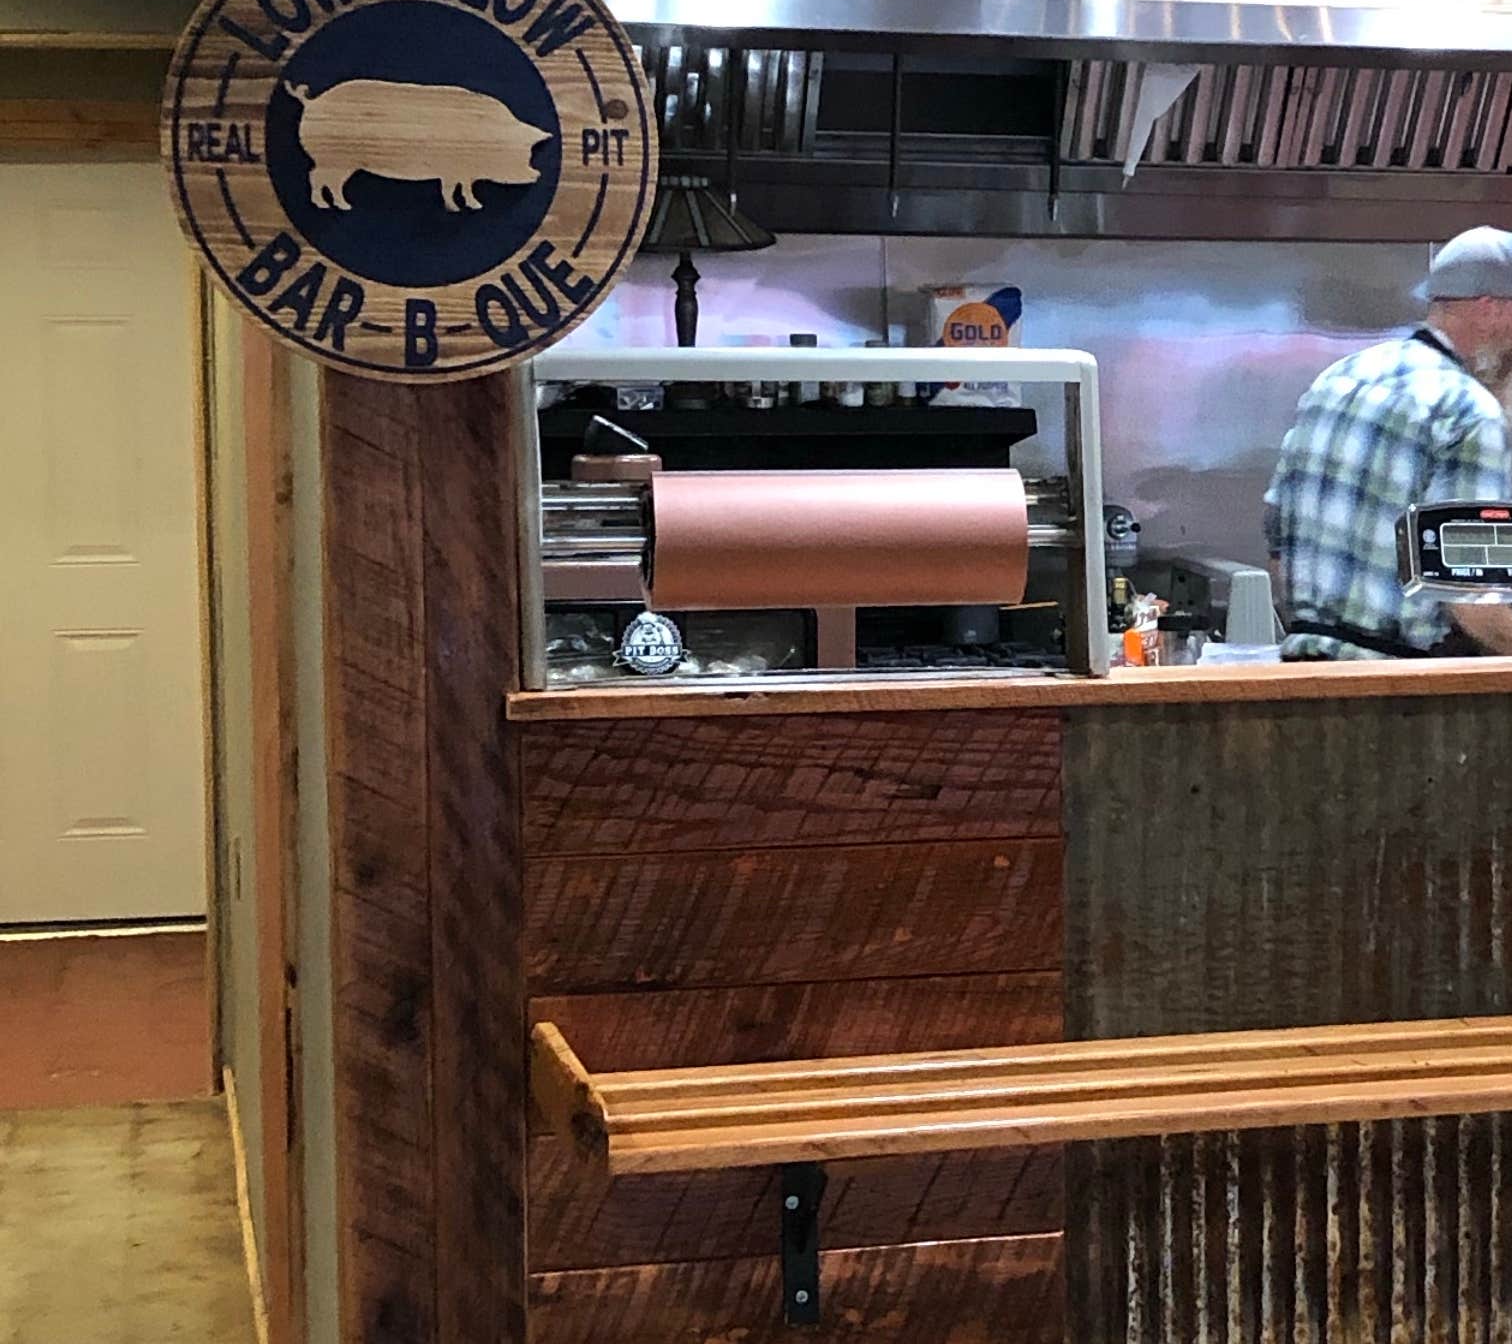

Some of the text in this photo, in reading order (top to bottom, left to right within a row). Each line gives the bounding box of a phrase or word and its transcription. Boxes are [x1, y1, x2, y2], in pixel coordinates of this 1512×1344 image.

[186, 121, 262, 164] REAL
[582, 127, 629, 167] PIT
[951, 322, 1002, 340] GOLD
[625, 646, 679, 656] PIT BOSS
